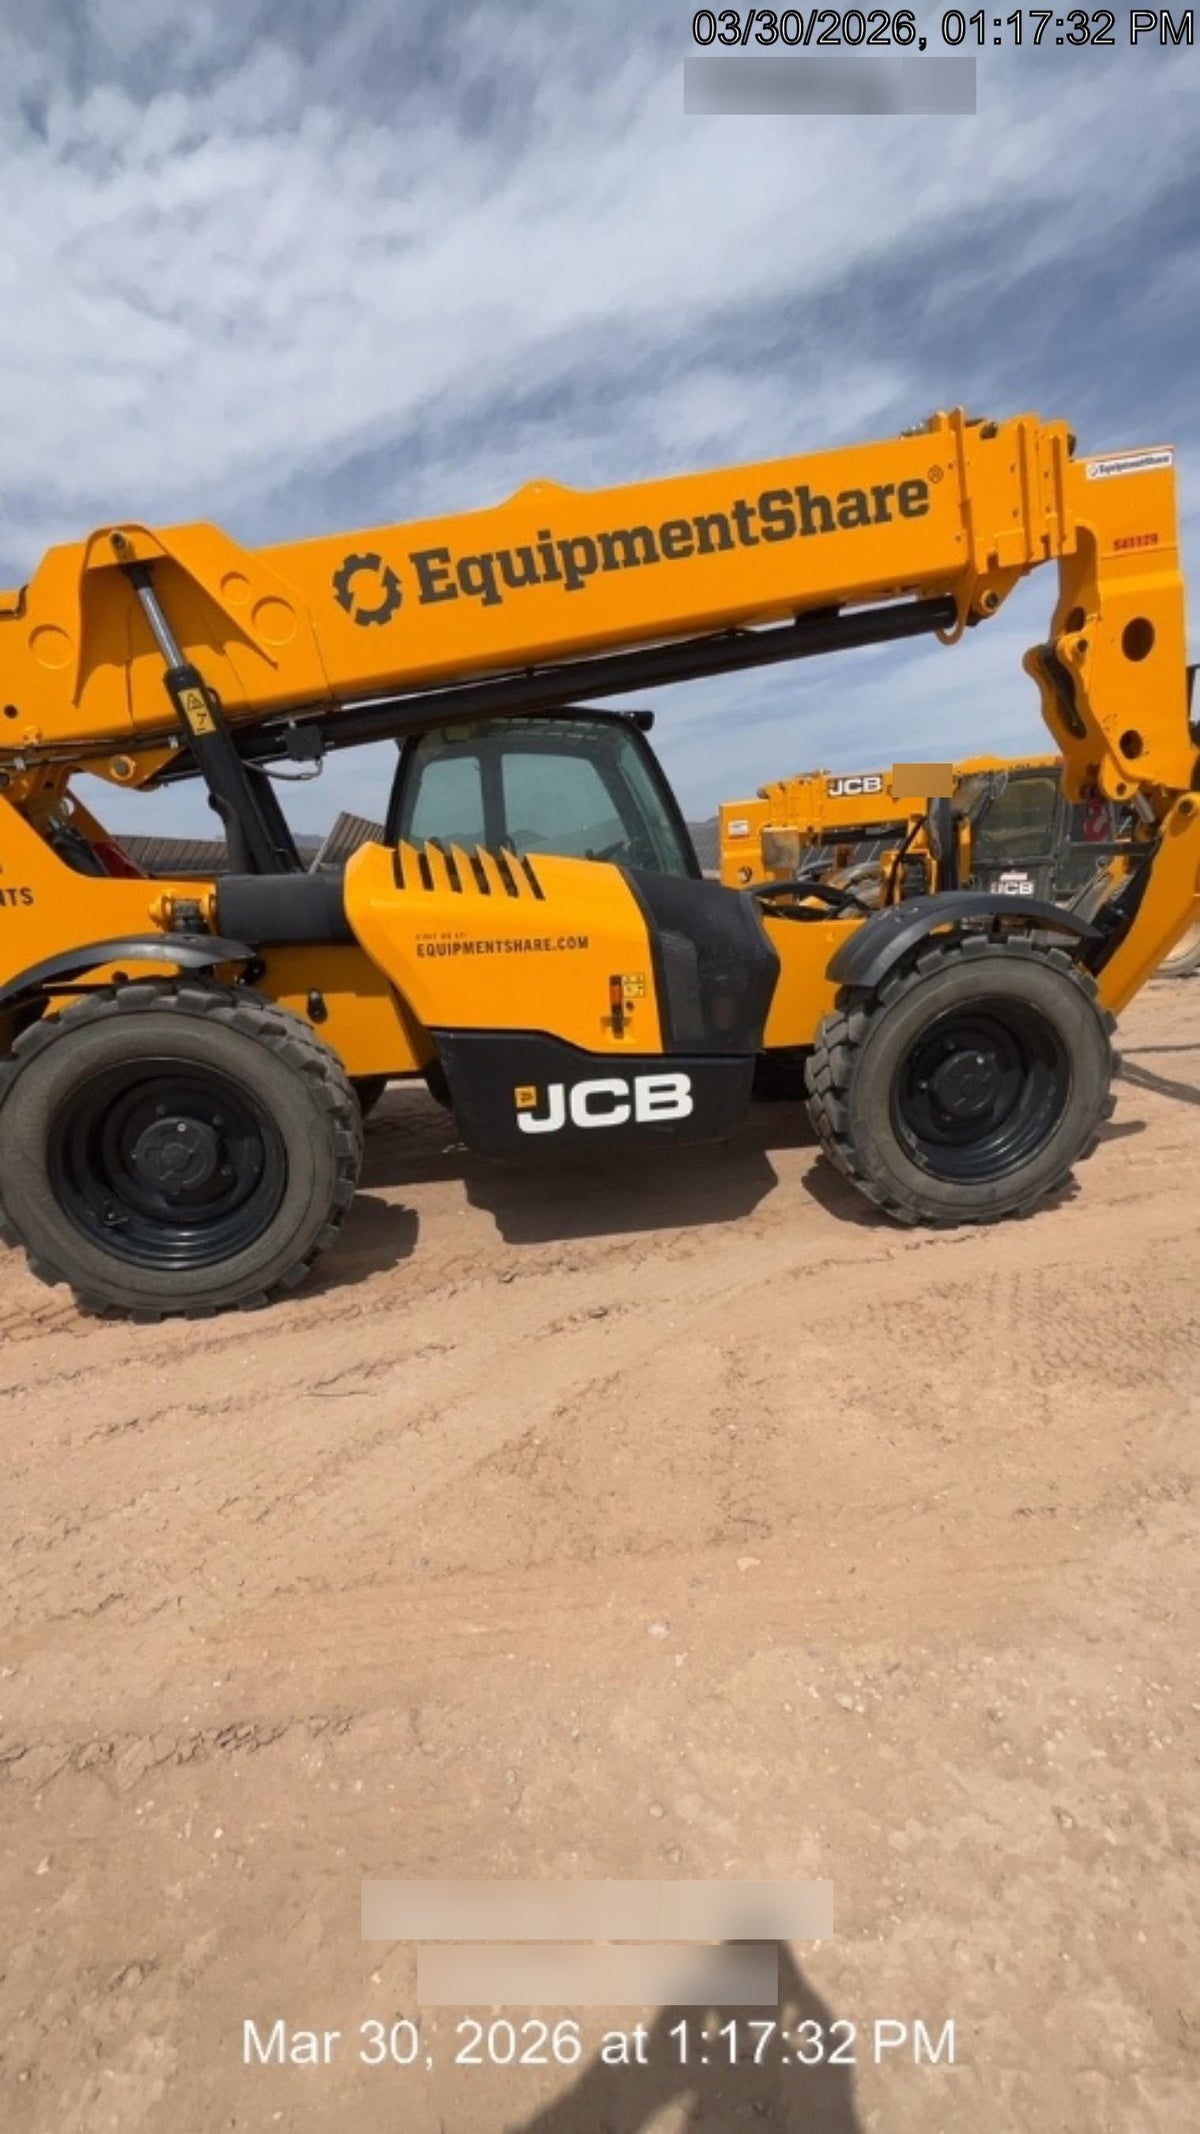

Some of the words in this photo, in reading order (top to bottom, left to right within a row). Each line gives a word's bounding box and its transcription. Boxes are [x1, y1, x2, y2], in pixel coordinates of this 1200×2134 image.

[828, 776, 881, 796] JCB
[416, 935, 589, 958] EQUIPMENTSHARE.COM
[515, 1073, 694, 1134] JCB
